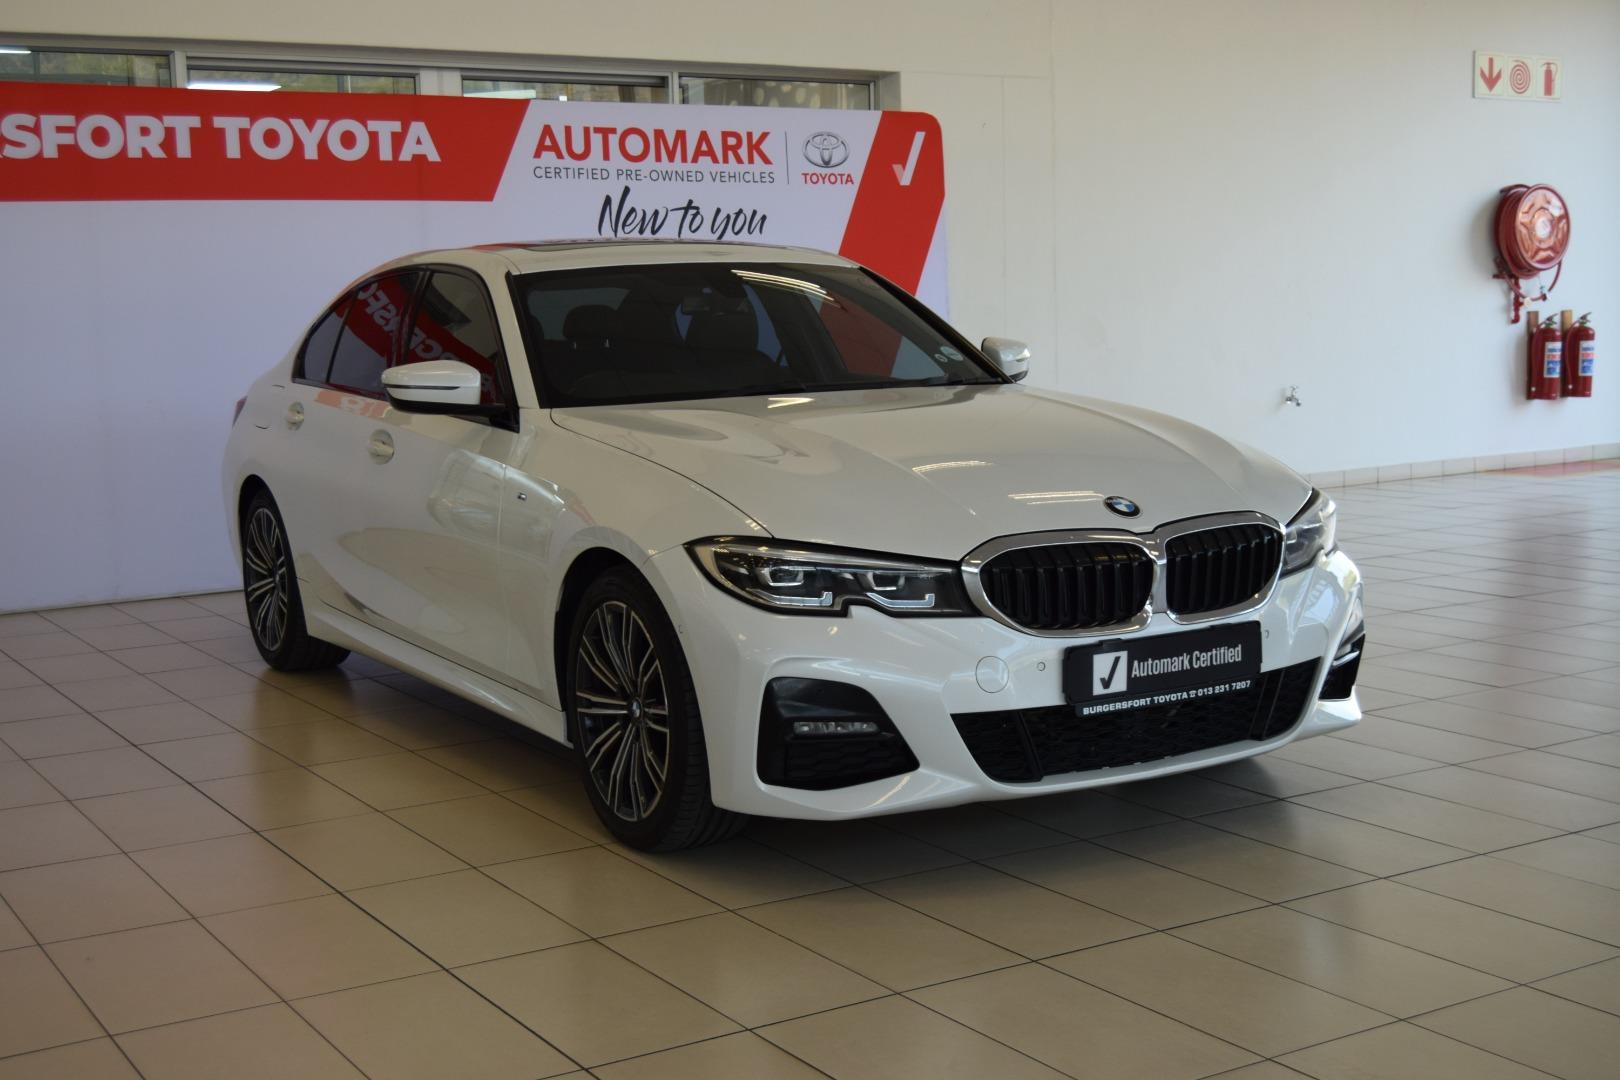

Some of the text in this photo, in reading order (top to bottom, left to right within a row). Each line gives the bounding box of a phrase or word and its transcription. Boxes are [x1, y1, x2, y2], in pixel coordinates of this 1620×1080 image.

[0, 113, 442, 162] SFORT TOYOTA
[533, 123, 773, 166] AUTOMARK
[533, 166, 776, 184] CERTIFIED PRE-OWNED VEHICLES
[803, 172, 855, 185] TOYOTA
[598, 185, 768, 240] New to you
[1131, 644, 1242, 678] Automark Certified
[1082, 680, 1251, 715] BURGERSFORT TOYOTA 013 231 7207
